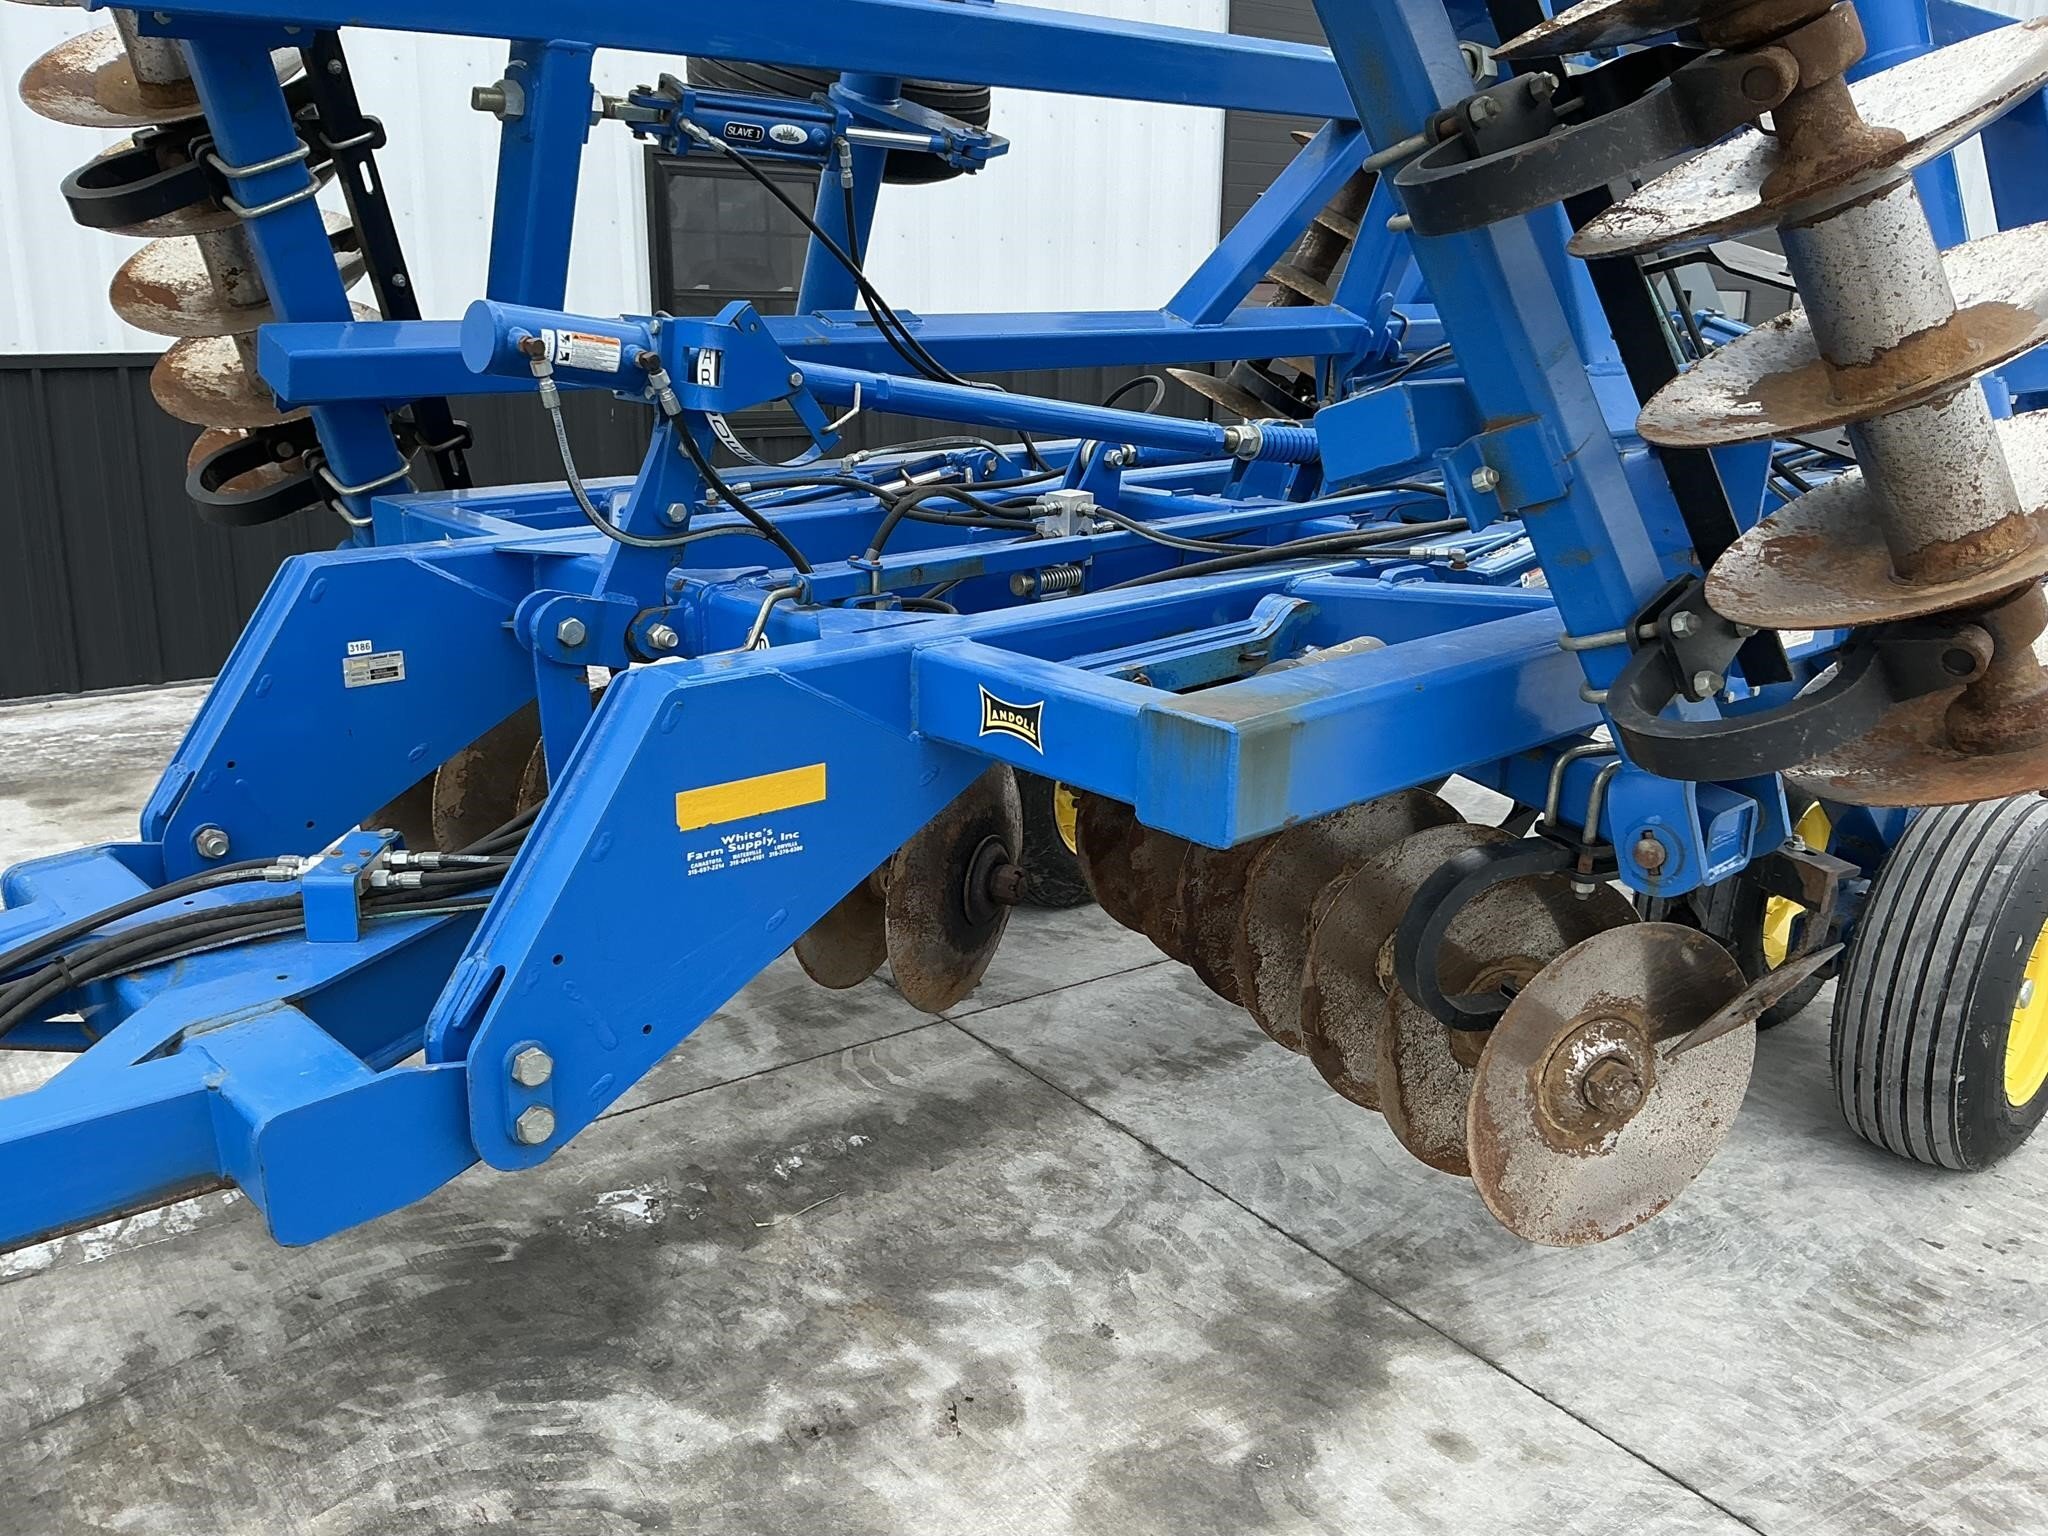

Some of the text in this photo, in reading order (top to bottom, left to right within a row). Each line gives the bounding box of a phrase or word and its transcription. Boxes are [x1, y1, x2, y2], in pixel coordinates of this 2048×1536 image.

[727, 125, 754, 138] SLAVE
[350, 642, 370, 652] 3186
[986, 697, 1037, 741] LANDOLL
[721, 828, 773, 845] White's
[687, 831, 800, 862] Farm Supply, Inc
